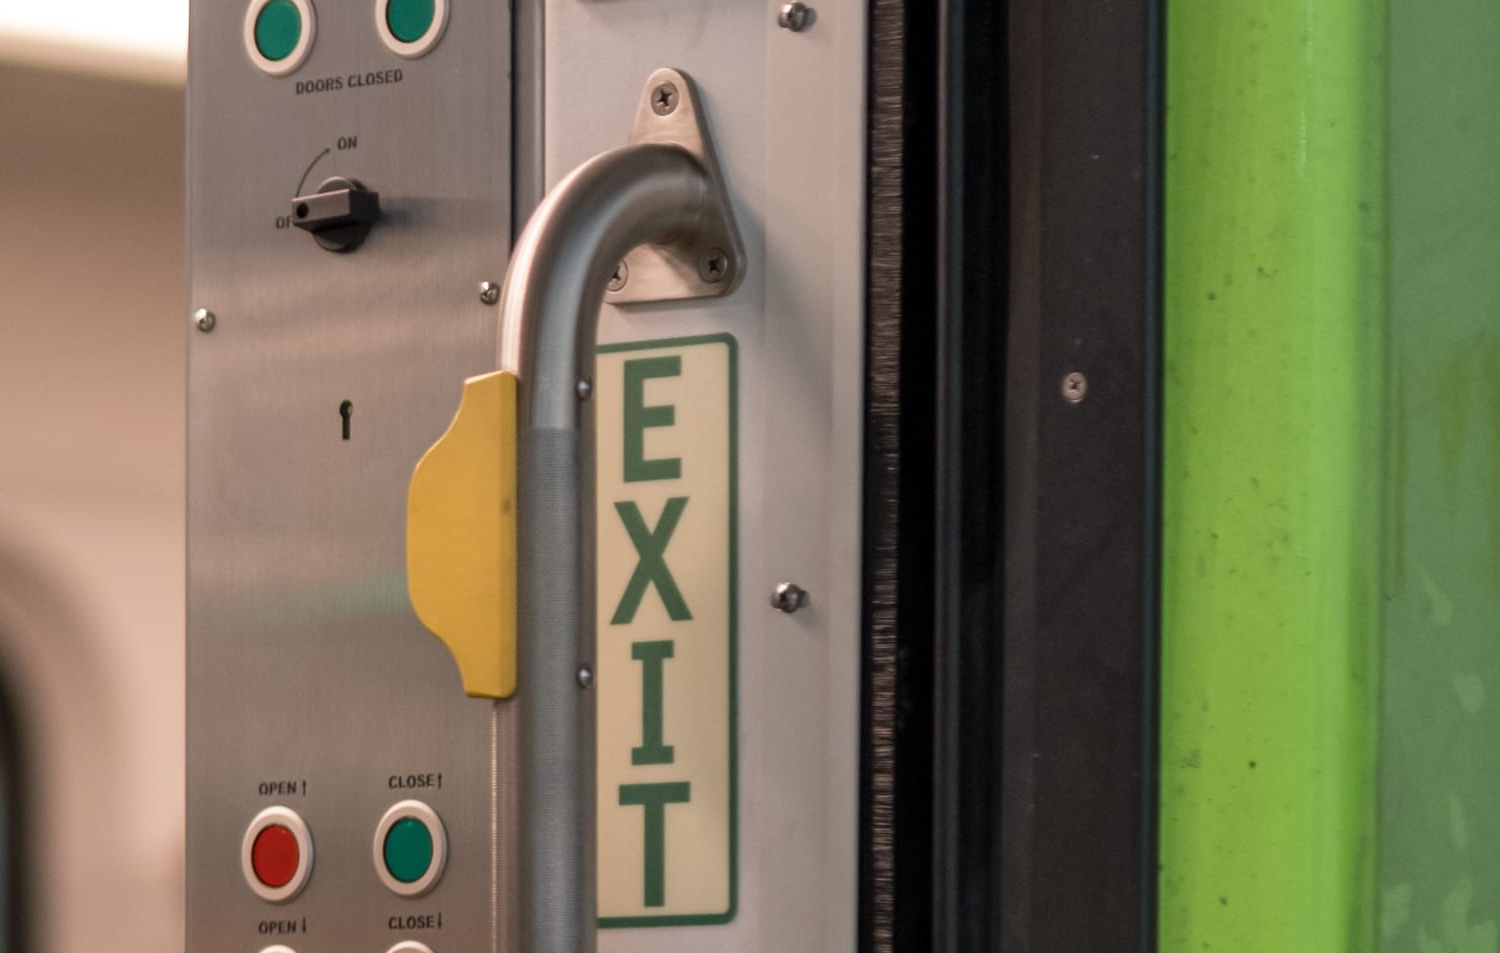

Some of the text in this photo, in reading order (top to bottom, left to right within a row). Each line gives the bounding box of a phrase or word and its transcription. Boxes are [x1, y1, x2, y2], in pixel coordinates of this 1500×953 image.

[296, 69, 403, 95] DOORS CLOSED
[337, 136, 358, 150] ON
[610, 355, 693, 908] EXIT
[259, 781, 297, 796] OPEN
[388, 774, 435, 789] CLOSE
[258, 920, 297, 935] OPEN
[388, 915, 435, 930] CLOSE
